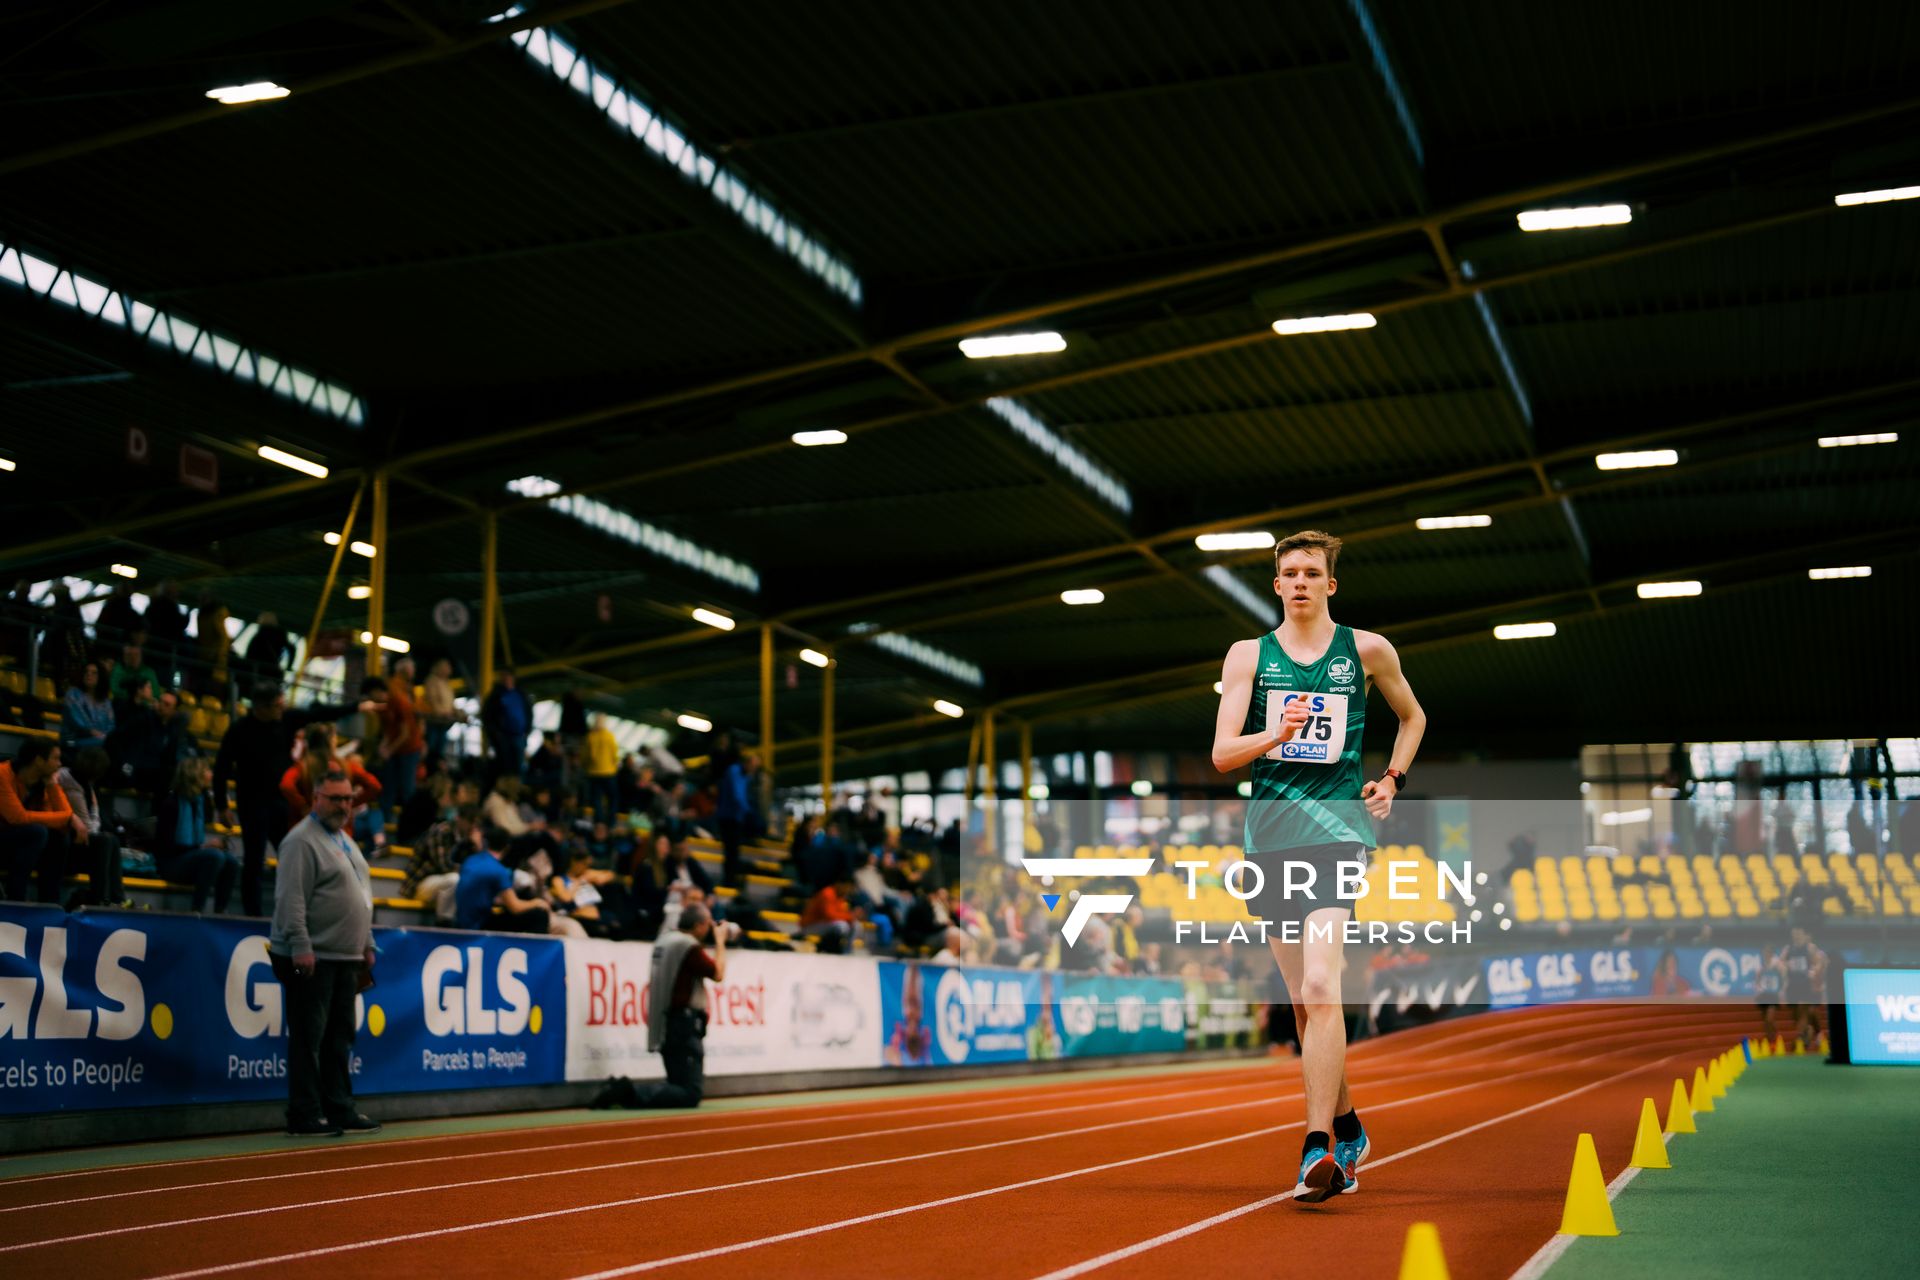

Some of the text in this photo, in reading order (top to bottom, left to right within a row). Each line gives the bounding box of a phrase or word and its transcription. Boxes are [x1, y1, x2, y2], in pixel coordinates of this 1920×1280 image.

[1280, 713, 1332, 742] 75
[1300, 745, 1326, 754] PLAN
[585, 963, 650, 1027] Blac
[228, 1053, 287, 1080] Parcels
[422, 1047, 527, 1072] Parcels to People
[44, 1061, 67, 1086] to
[72, 1056, 144, 1092] People
